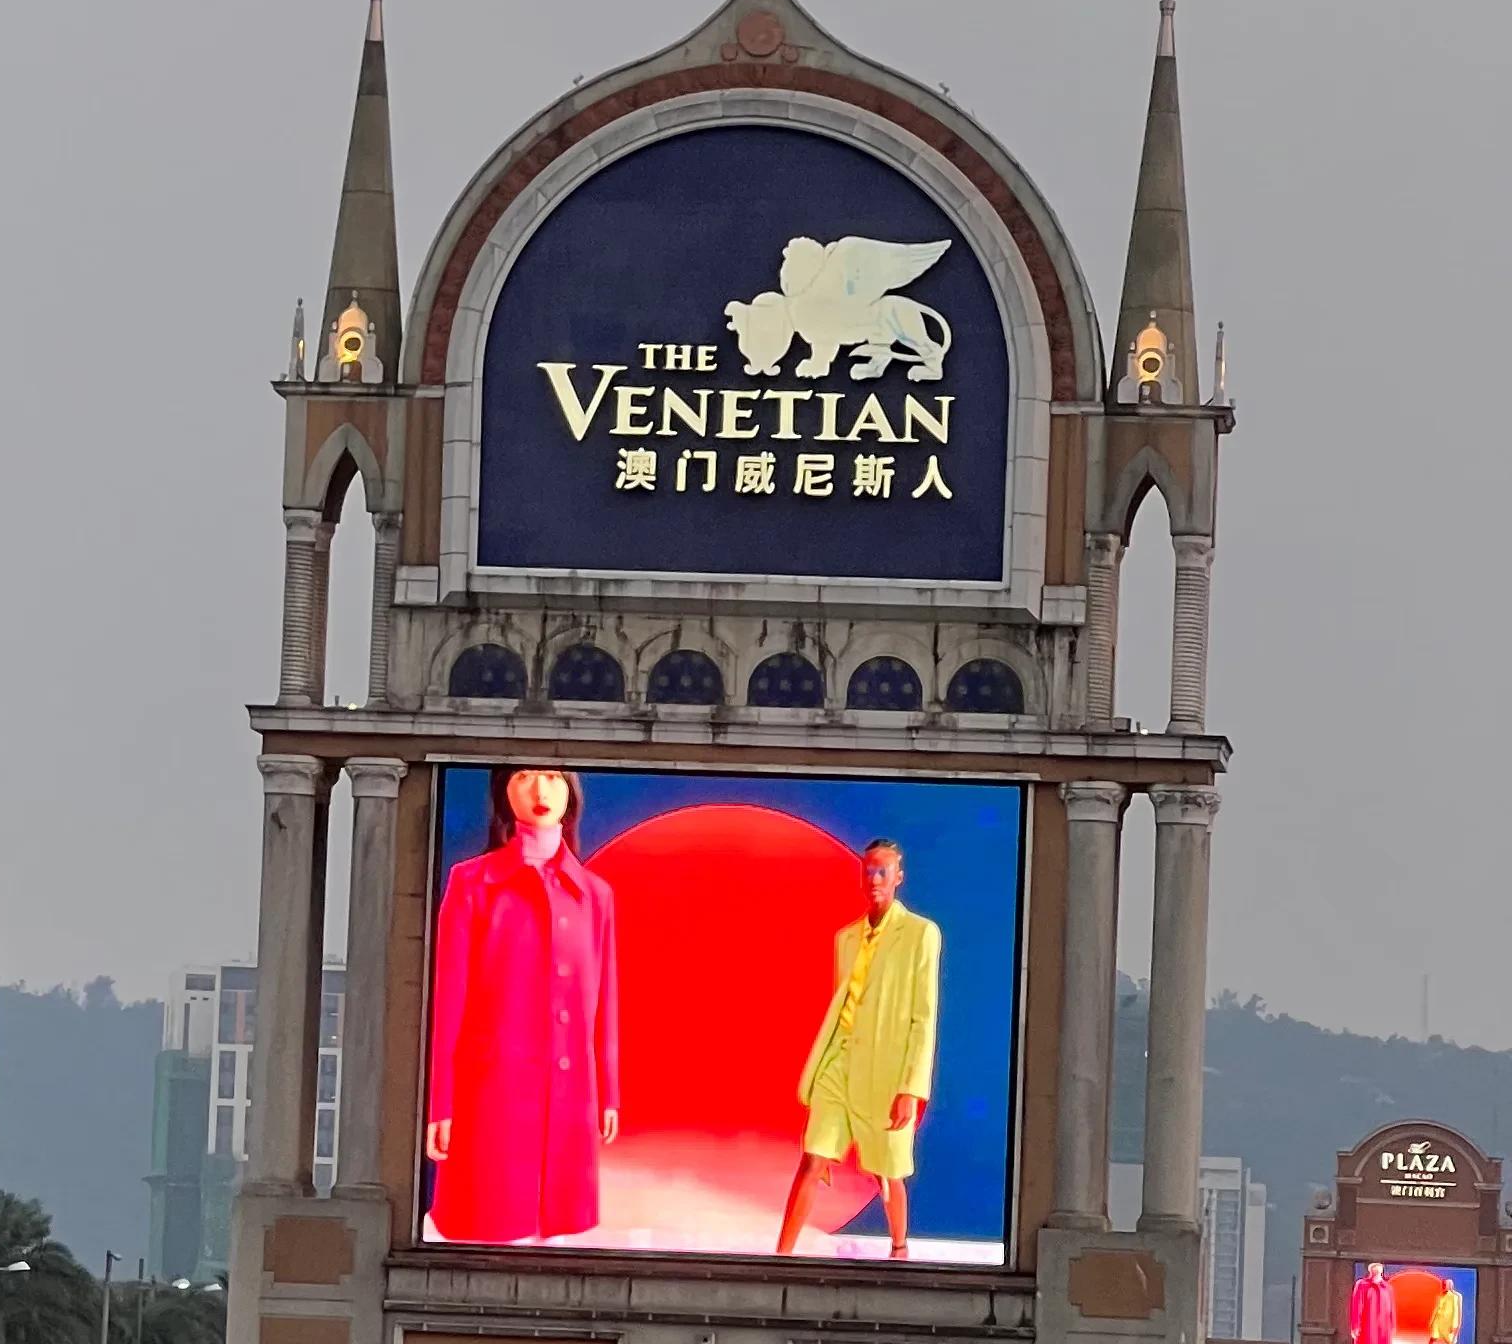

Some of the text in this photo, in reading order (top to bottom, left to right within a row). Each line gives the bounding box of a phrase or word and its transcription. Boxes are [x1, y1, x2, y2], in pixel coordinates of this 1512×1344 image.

[638, 342, 718, 372] THE
[536, 361, 956, 445] VENETIAN
[615, 447, 953, 500] 澳门威尼斯人
[1381, 1152, 1456, 1173] PLAZA
